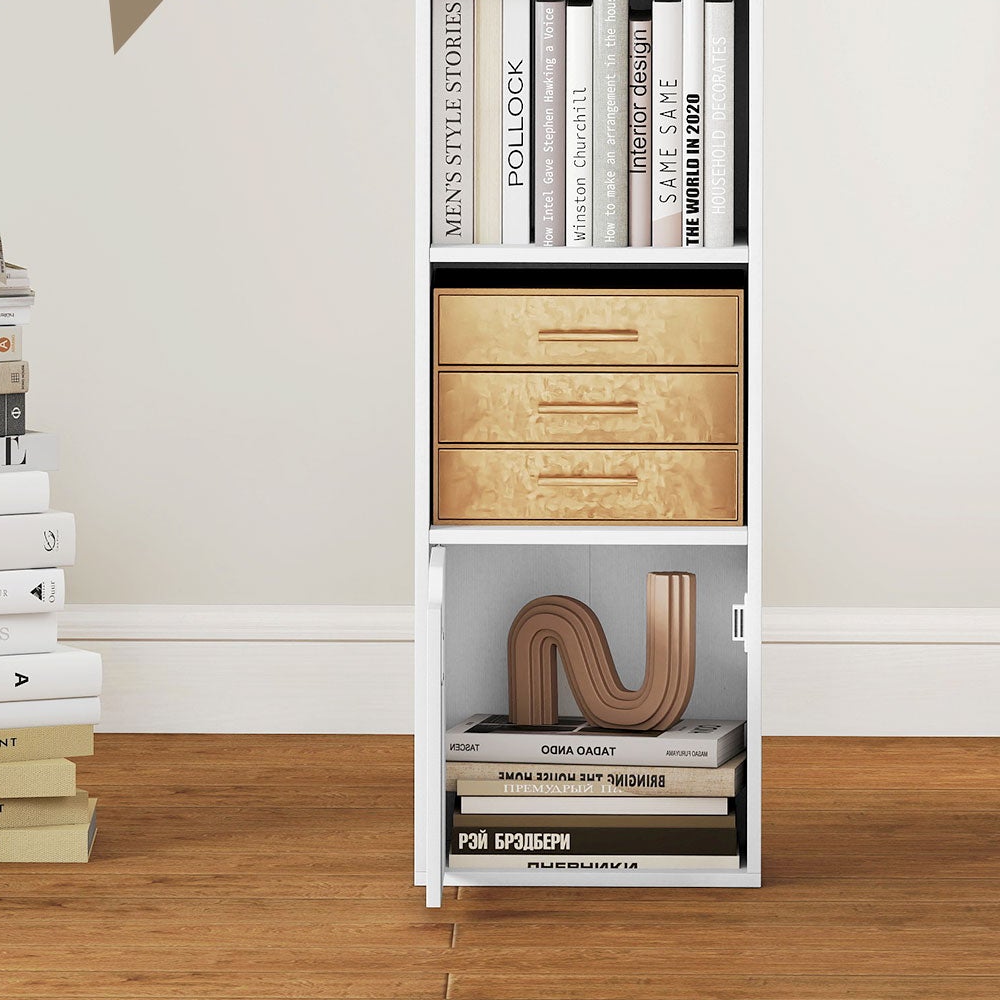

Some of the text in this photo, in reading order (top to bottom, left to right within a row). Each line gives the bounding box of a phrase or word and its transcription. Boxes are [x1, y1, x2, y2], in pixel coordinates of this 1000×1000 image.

[543, 7, 554, 40] Voice
[605, 28, 616, 47] the
[604, 54, 616, 67] in
[543, 58, 557, 103] Hawking
[605, 74, 618, 145] arrangement
[629, 29, 651, 174] Interior design
[445, 2, 462, 237] MEN'S STYLE STORIES
[507, 59, 524, 187] POLLOCK
[543, 107, 556, 152] Stephen
[711, 36, 727, 215] HOUSEHOLD DECORATES
[659, 79, 678, 203] SAME SAME
[543, 159, 554, 185] Gave
[572, 87, 587, 241] Winston Churchill
[606, 151, 616, 165] an
[686, 93, 700, 246] THE WORLD IN 2020
[604, 170, 616, 198] make
[543, 190, 554, 221] Intel
[604, 204, 616, 217] to
[543, 226, 554, 247] How
[604, 222, 616, 243] How
[14, 672, 29, 688] A
[503, 783, 594, 793] ПРЕМУДРЫЙ
[458, 829, 571, 851] РЭЙ БРЭДБЕРИ
